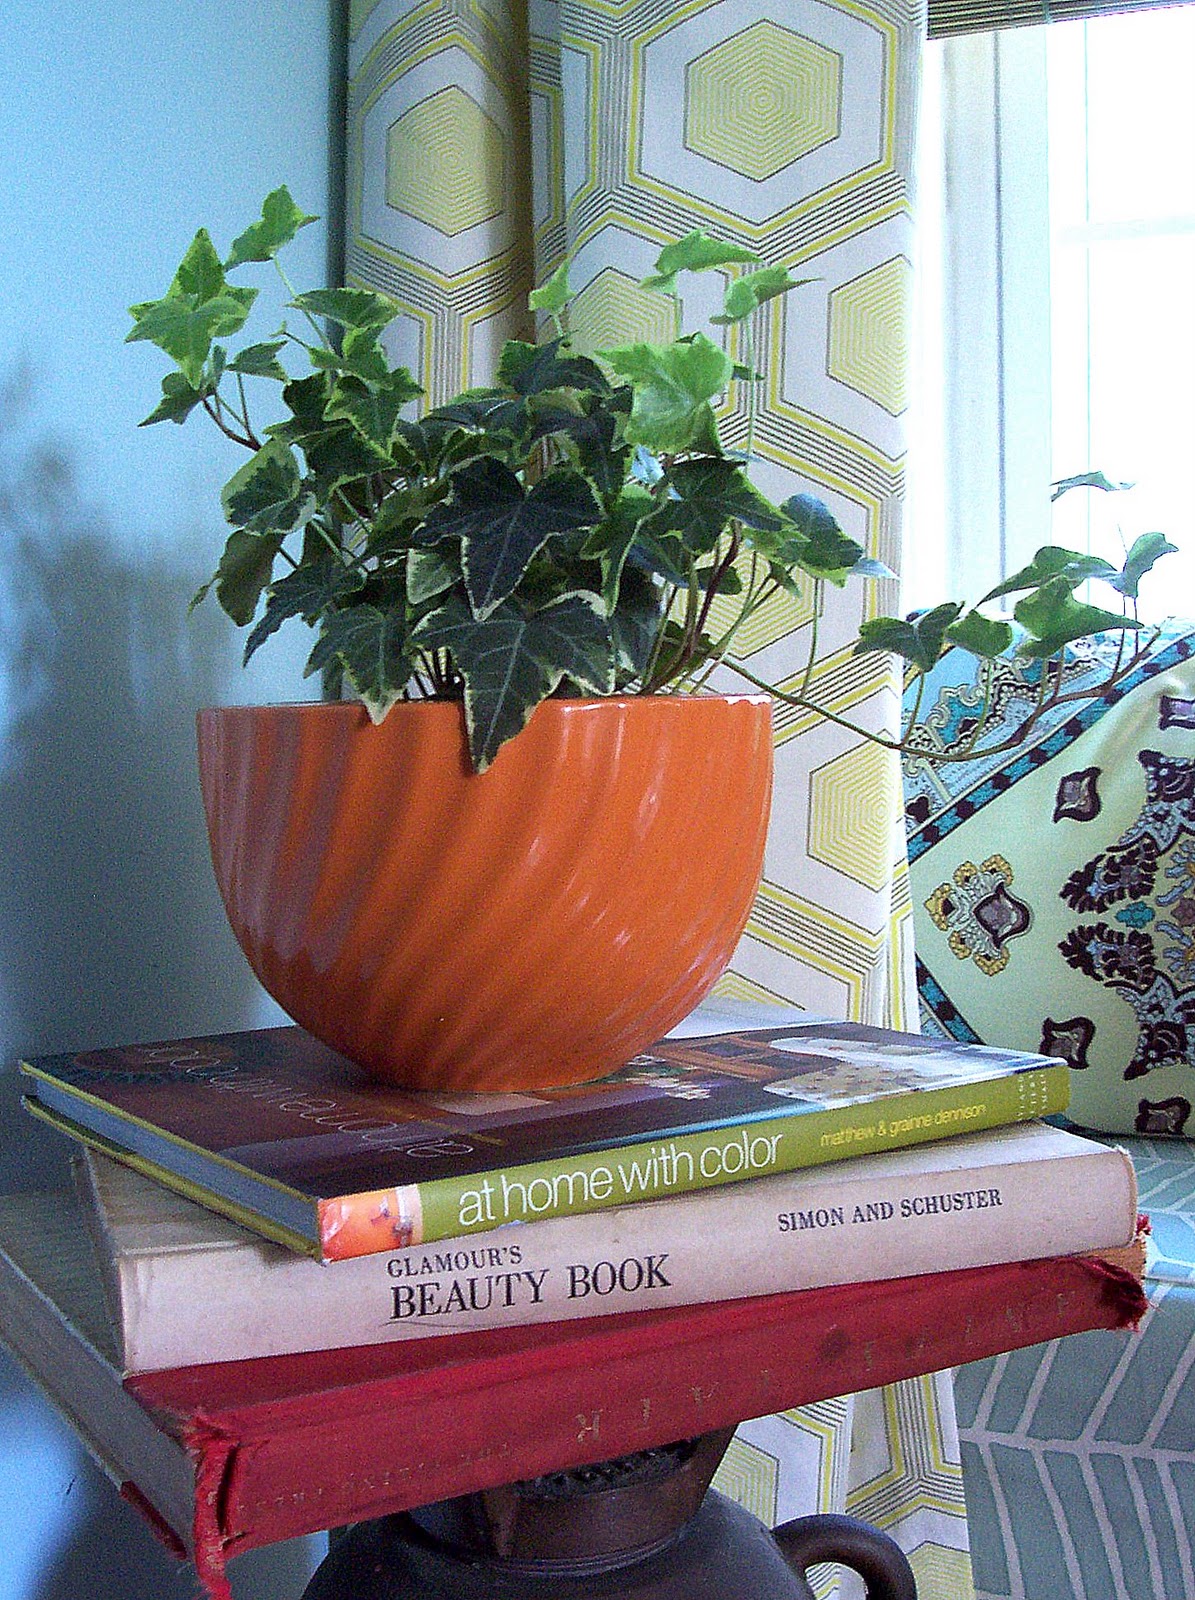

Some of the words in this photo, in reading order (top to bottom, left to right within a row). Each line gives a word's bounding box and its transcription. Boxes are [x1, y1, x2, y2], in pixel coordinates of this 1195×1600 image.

[820, 1126, 876, 1147] matthew
[877, 1120, 888, 1137] &
[459, 1180, 497, 1226] at
[501, 1167, 613, 1216] home
[618, 1144, 694, 1193] with
[699, 1129, 784, 1178] color
[778, 1207, 844, 1231] SIMON
[852, 1202, 894, 1224] AND
[901, 1188, 1003, 1218] SCHUSTER
[387, 1246, 523, 1277] GLAMOUR'S
[389, 1269, 550, 1319] BEAUTY
[567, 1254, 672, 1298] BOOK
